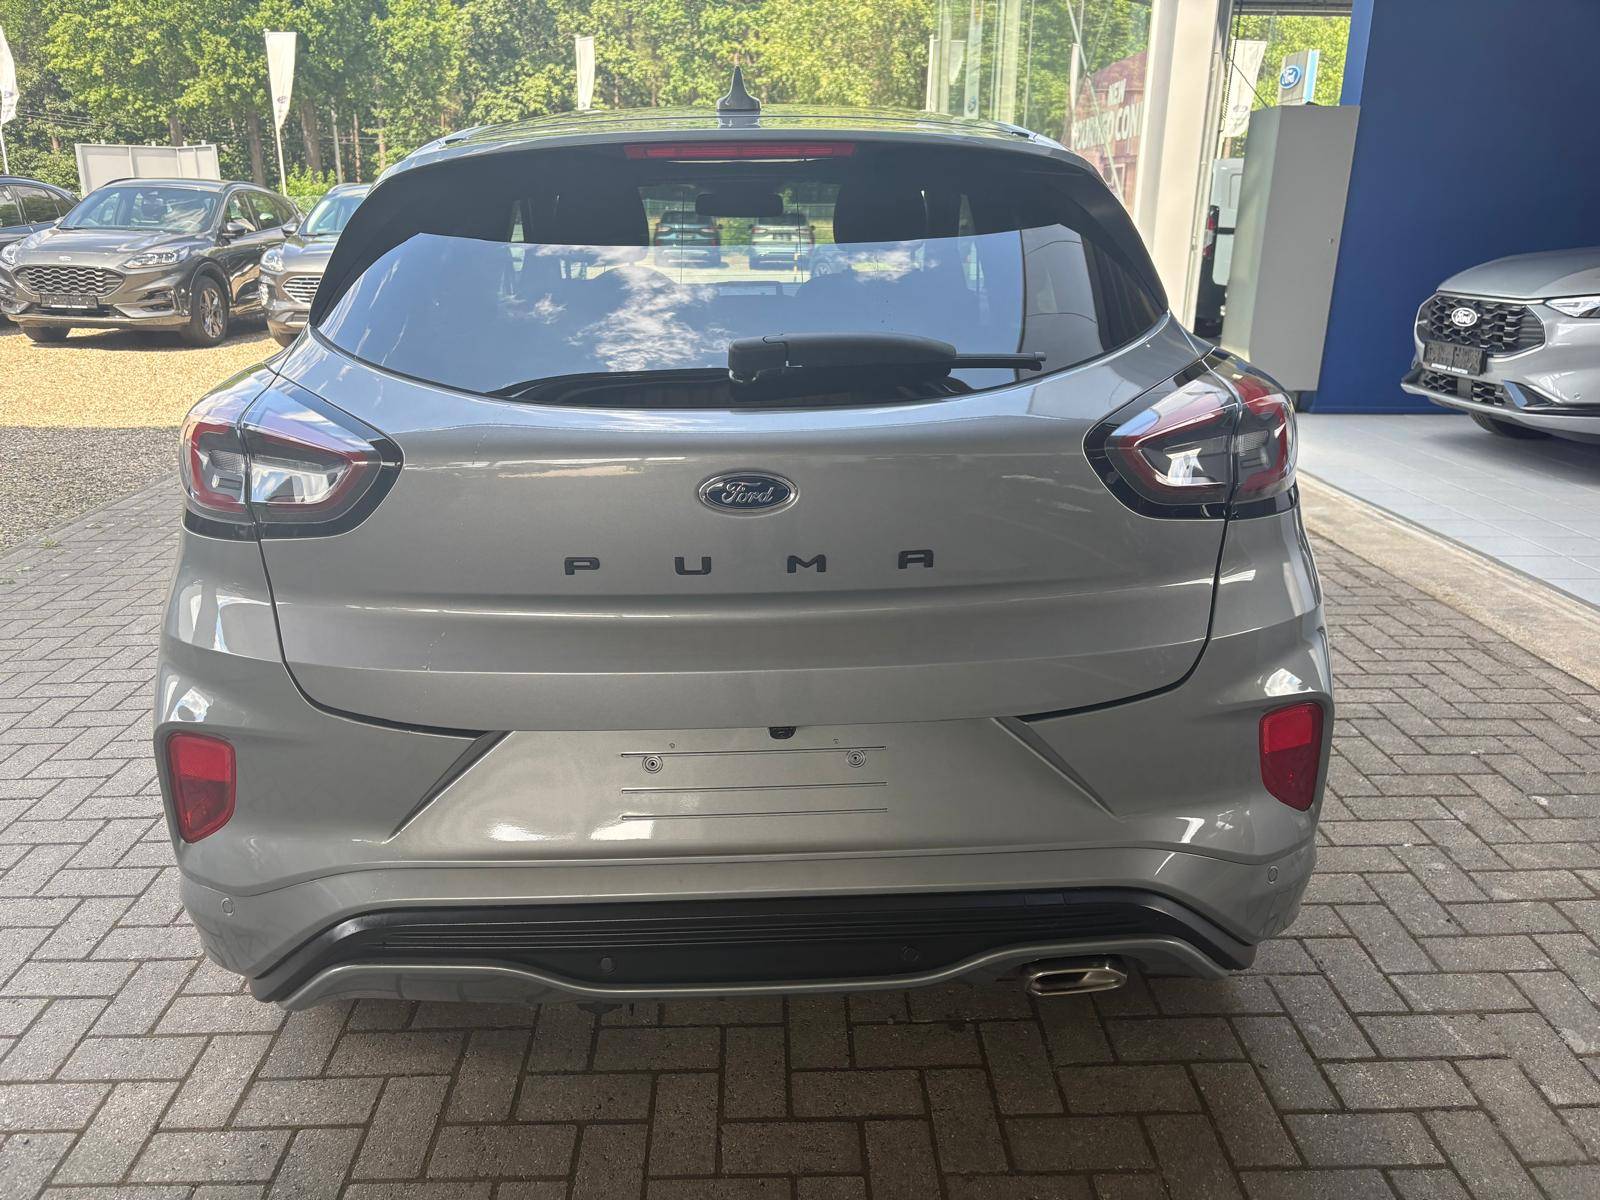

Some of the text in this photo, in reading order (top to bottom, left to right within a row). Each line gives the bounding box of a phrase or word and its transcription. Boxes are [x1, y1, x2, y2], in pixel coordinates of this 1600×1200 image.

[1108, 78, 1127, 106] NEW
[721, 482, 774, 504] Ford
[564, 549, 934, 576] PUMA
